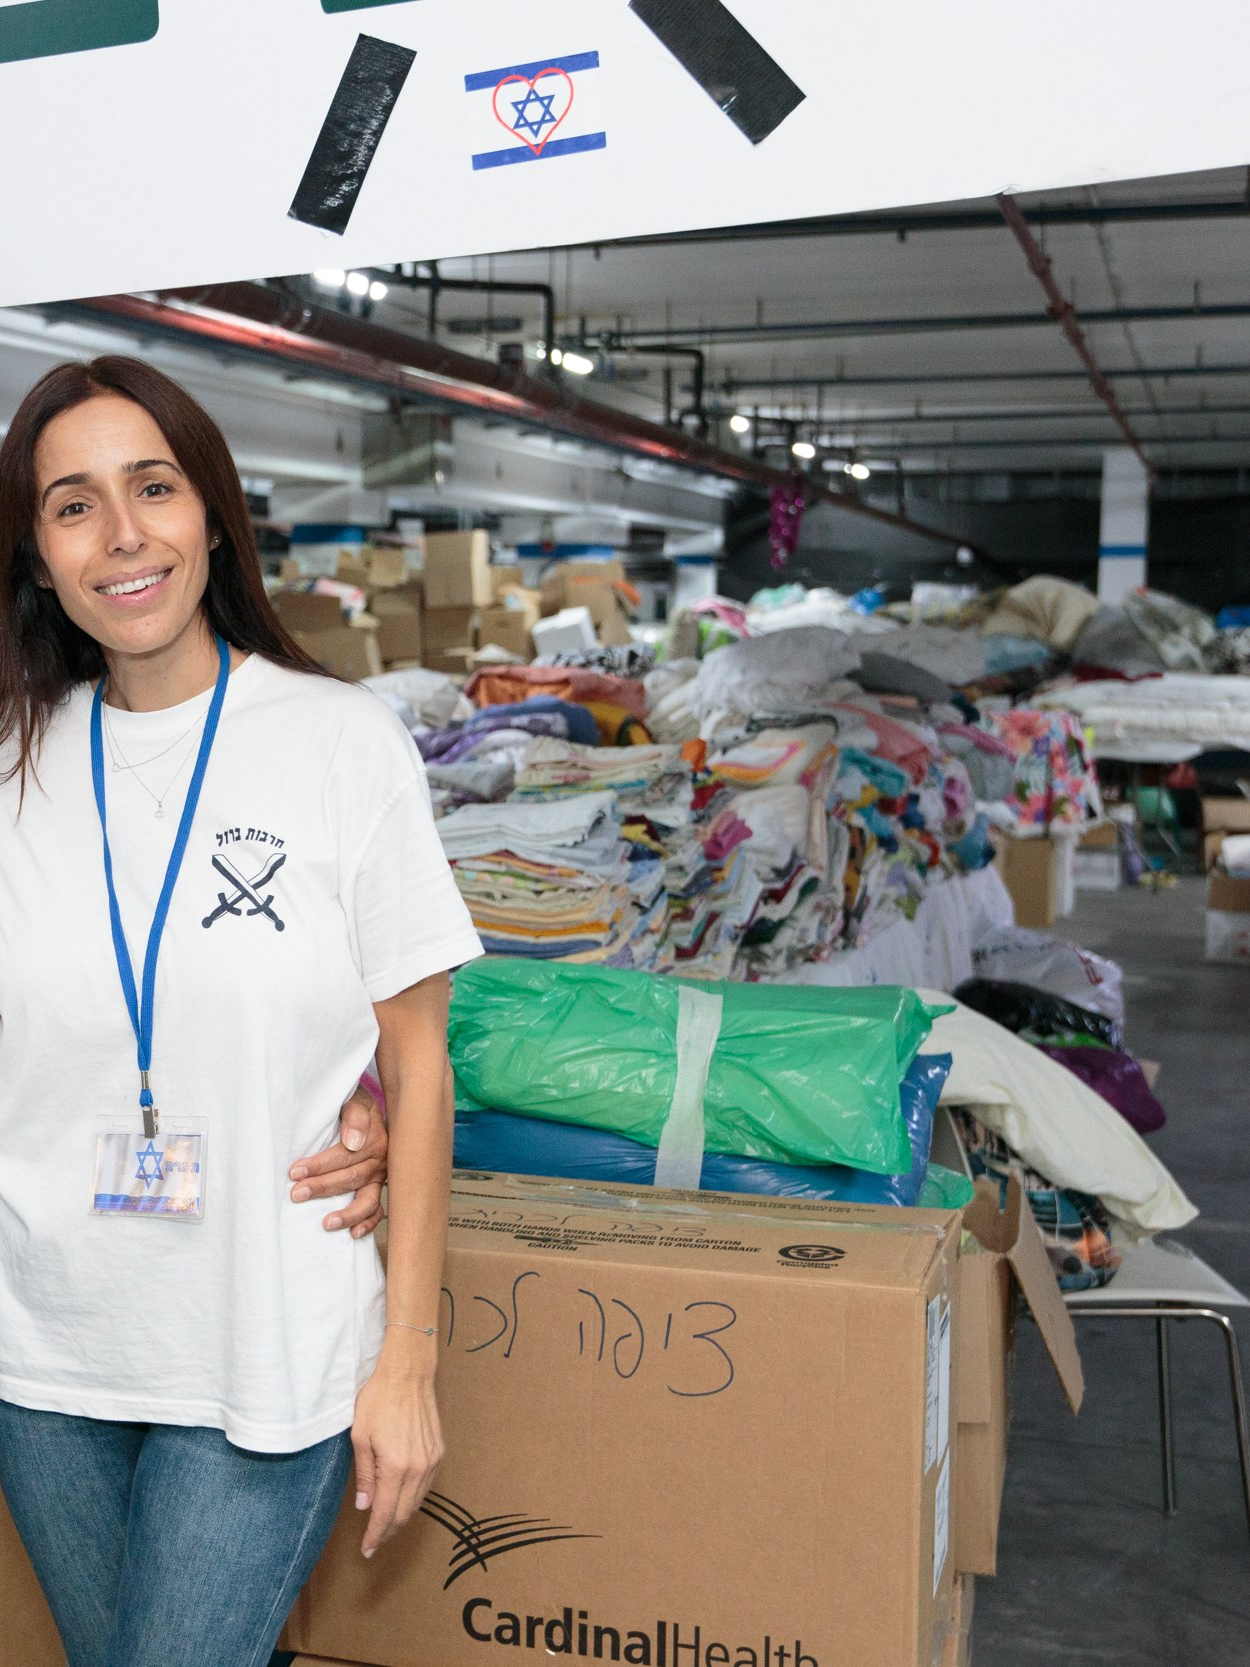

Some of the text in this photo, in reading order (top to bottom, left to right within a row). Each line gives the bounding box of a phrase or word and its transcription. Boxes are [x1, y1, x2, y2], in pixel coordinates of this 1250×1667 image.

[215, 827, 285, 849] חרבות ברזל
[461, 1218, 491, 1226] WITH
[491, 1220, 522, 1229] BOTH
[522, 1223, 561, 1233] HANDS
[563, 1228, 597, 1236] WHEN
[598, 1231, 658, 1241] REMOVING
[695, 1238, 742, 1246] CARTON
[479, 1224, 536, 1235] HANDLING
[562, 1232, 616, 1243] SHELVING
[618, 1238, 655, 1246] PACKS
[711, 1245, 762, 1253] DAMAGE
[527, 1242, 578, 1252] CAUTION
[440, 1271, 737, 1397] ציפה לכר
[461, 1597, 819, 1667] CardinalHealth
